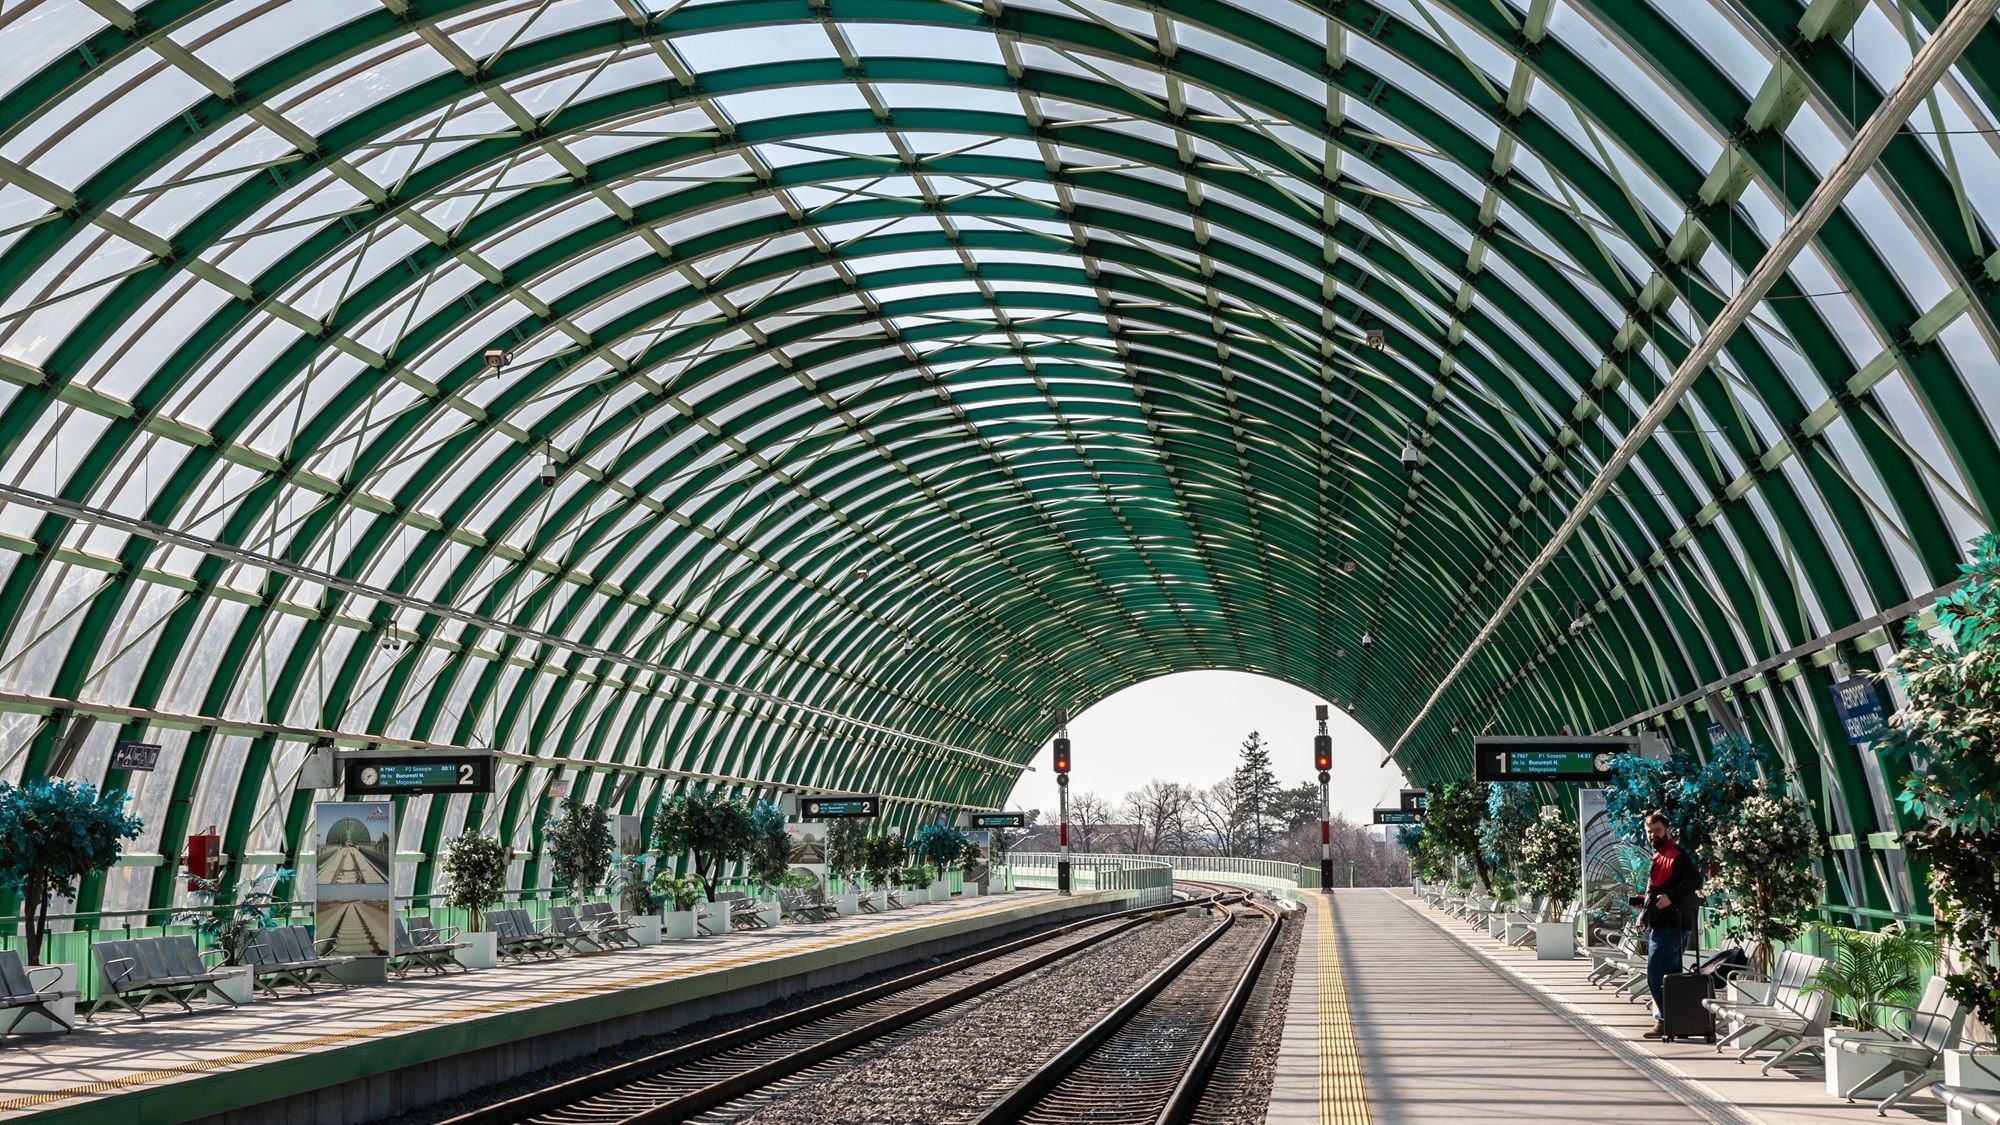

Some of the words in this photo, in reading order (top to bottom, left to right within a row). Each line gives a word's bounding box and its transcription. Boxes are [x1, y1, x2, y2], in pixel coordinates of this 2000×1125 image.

[1840, 684, 1869, 710] AEROPORT
[1496, 752, 1506, 773] 1
[459, 764, 474, 785] 2
[862, 801, 871, 813] 2
[1411, 797, 1417, 808] 1
[1013, 817, 1019, 825] 2
